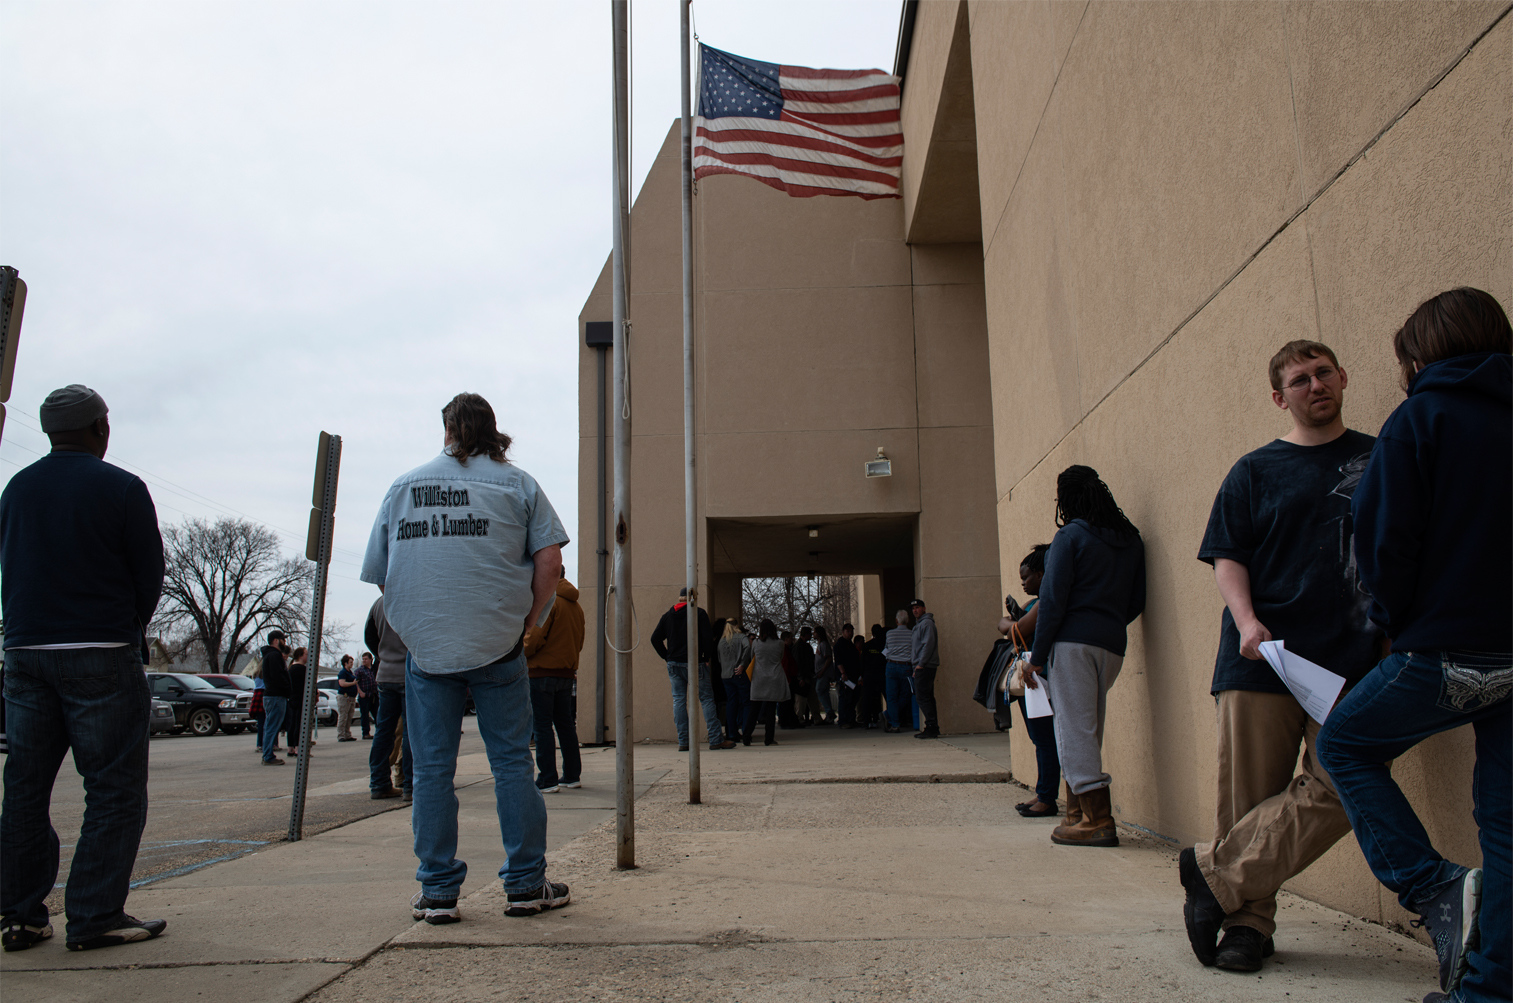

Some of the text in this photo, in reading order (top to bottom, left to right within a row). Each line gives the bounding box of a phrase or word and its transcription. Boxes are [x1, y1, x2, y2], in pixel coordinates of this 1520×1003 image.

[411, 485, 470, 508] Williston
[396, 513, 490, 541] Home & Lumber
